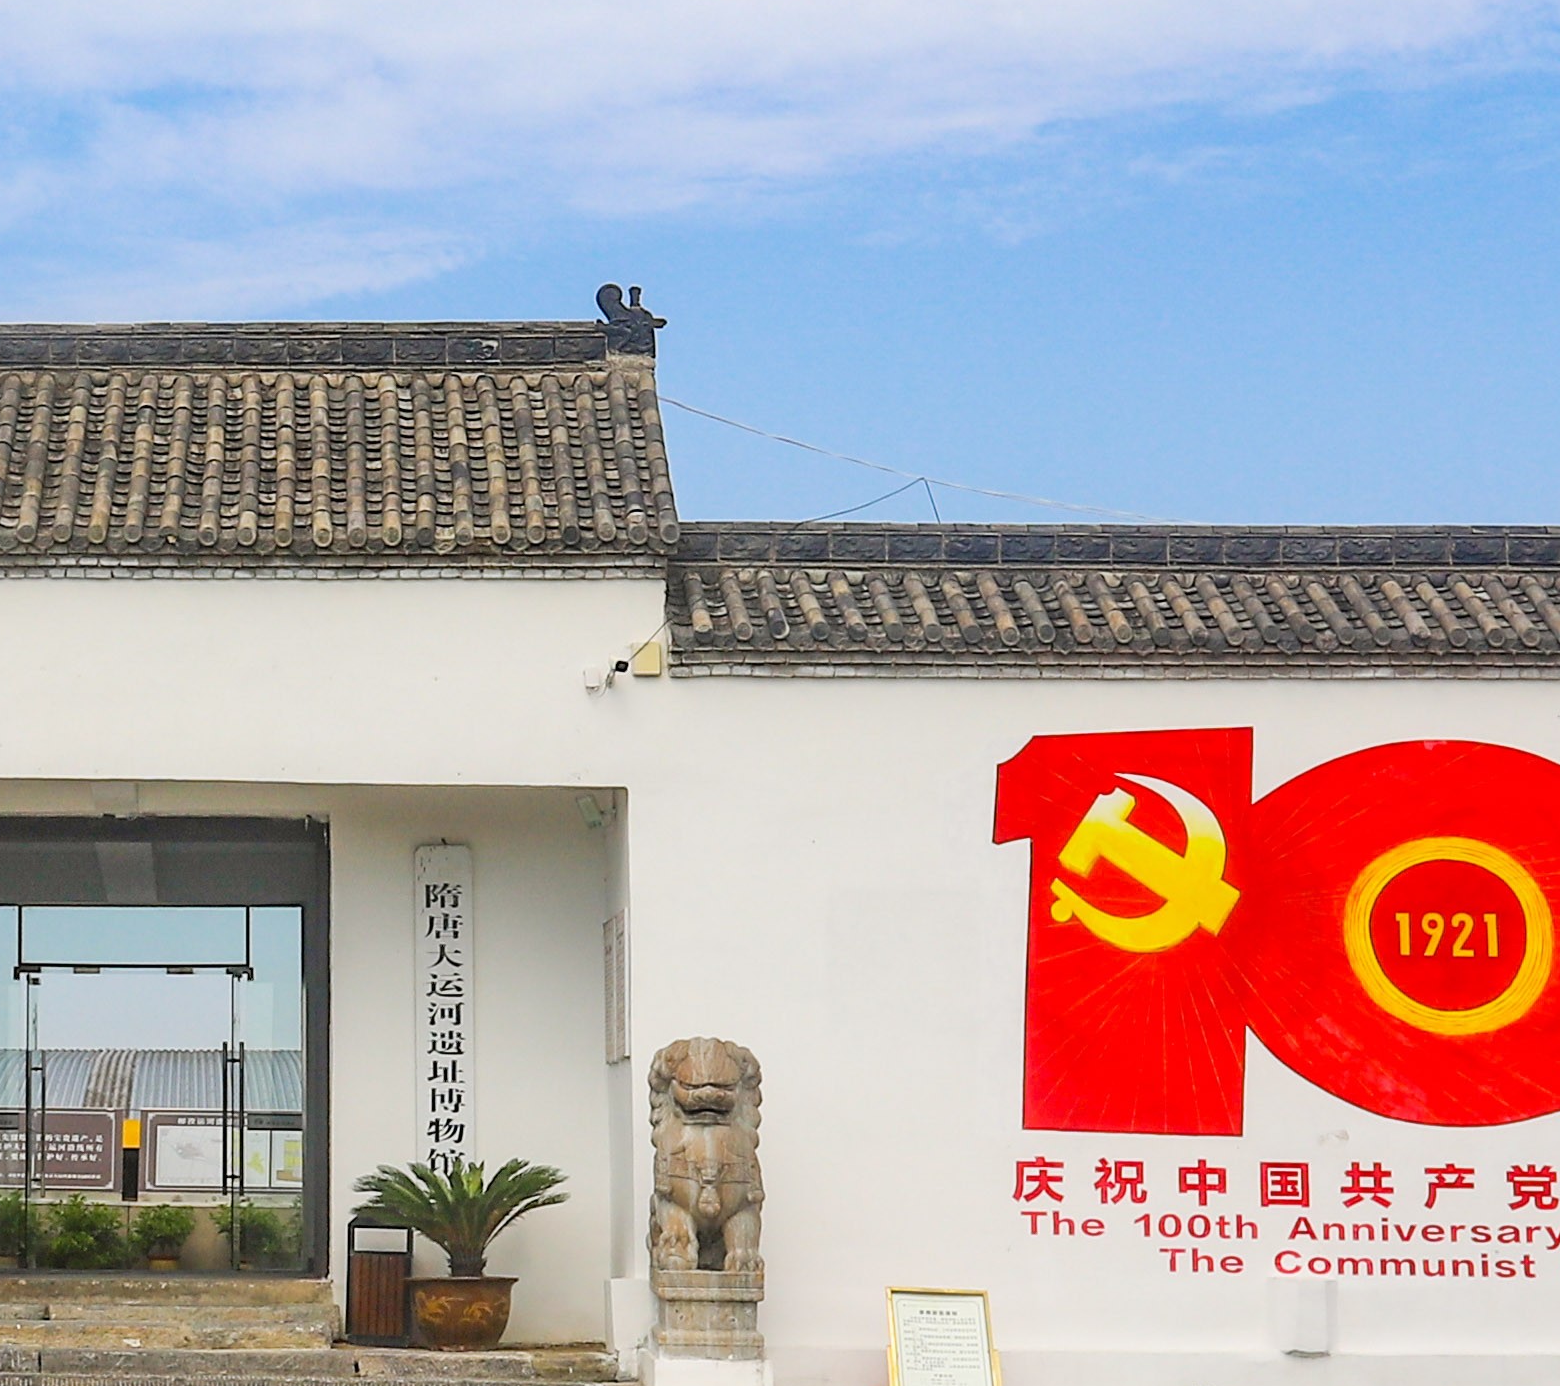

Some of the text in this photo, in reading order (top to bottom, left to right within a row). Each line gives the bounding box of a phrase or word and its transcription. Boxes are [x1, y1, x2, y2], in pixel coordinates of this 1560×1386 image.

[1395, 913, 1499, 958] 1921
[424, 882, 466, 1175] 隋唐大运河遗址博物馆
[1021, 1210, 1106, 1237] The
[1134, 1213, 1259, 1240] 100th
[1160, 1247, 1244, 1274] The
[1274, 1250, 1536, 1279] Communist
